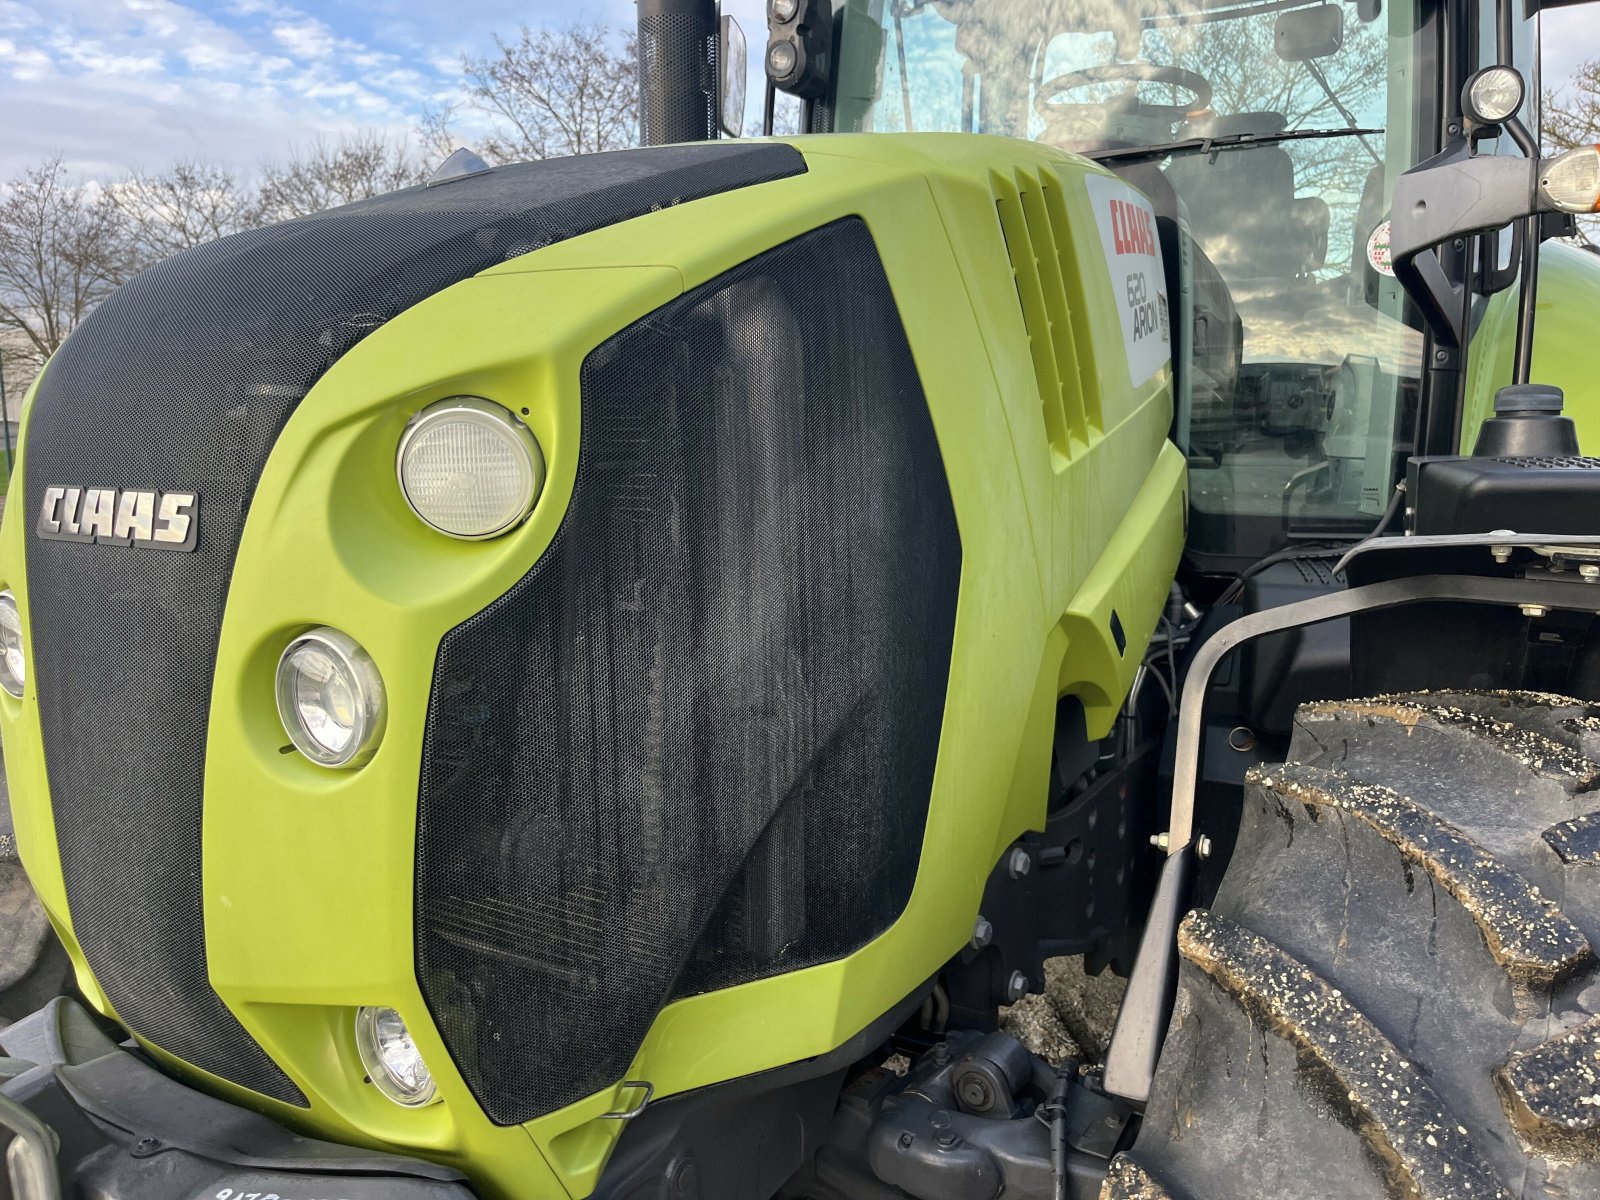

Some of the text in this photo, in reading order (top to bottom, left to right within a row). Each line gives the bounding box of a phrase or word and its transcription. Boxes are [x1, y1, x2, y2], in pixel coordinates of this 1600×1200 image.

[1109, 199, 1156, 257] CLAAS
[1126, 271, 1147, 308] 620
[1133, 300, 1159, 342] ARION
[40, 487, 195, 544] CLAAS
